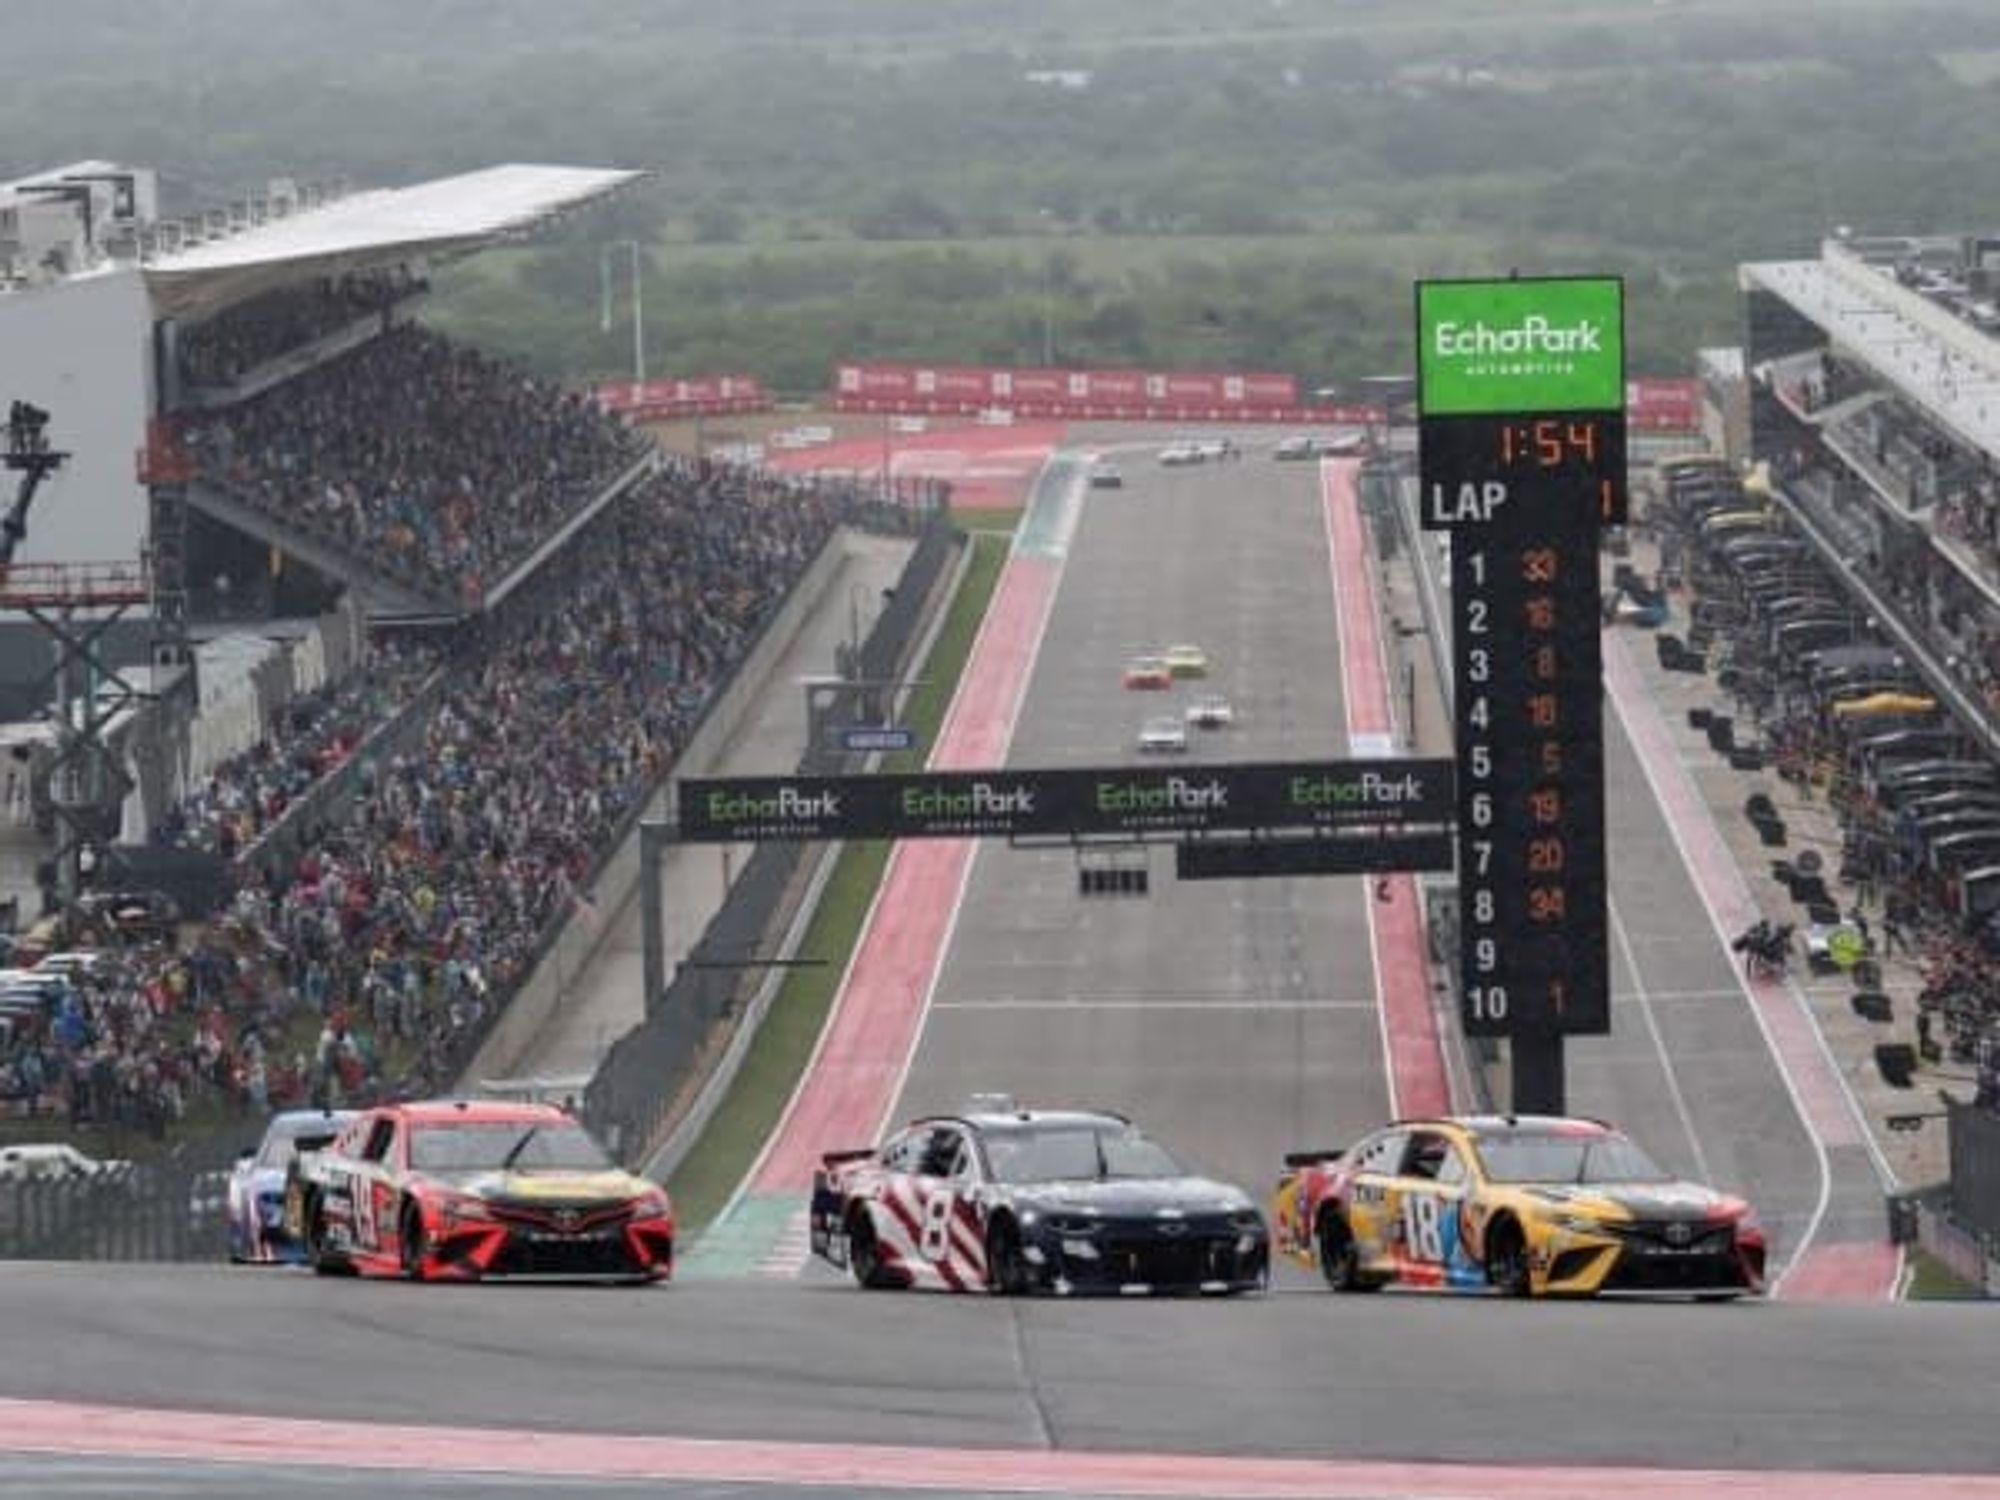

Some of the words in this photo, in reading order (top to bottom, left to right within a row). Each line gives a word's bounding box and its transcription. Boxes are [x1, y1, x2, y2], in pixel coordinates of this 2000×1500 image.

[1435, 315, 1601, 355] EchoPark
[1503, 422, 1595, 465] 1:54
[1432, 482, 1507, 521] LAP
[1601, 479, 1612, 518] 1
[1468, 553, 1484, 585] 1
[1467, 600, 1488, 632] 2
[1469, 649, 1489, 681] 3
[1470, 697, 1489, 730] 4
[1472, 746, 1491, 778] 5
[709, 787, 841, 821] EchoPark
[904, 783, 1035, 816] EchoPark
[1097, 777, 1228, 808] EchoPark
[1292, 773, 1423, 804] EchoPark
[1472, 793, 1492, 826] 6
[1473, 841, 1492, 874] 7
[1475, 890, 1494, 923] 8
[1476, 939, 1495, 971] 9
[1468, 986, 1507, 1018] 10
[921, 1192, 952, 1260] 8
[1403, 1190, 1444, 1261] 18
